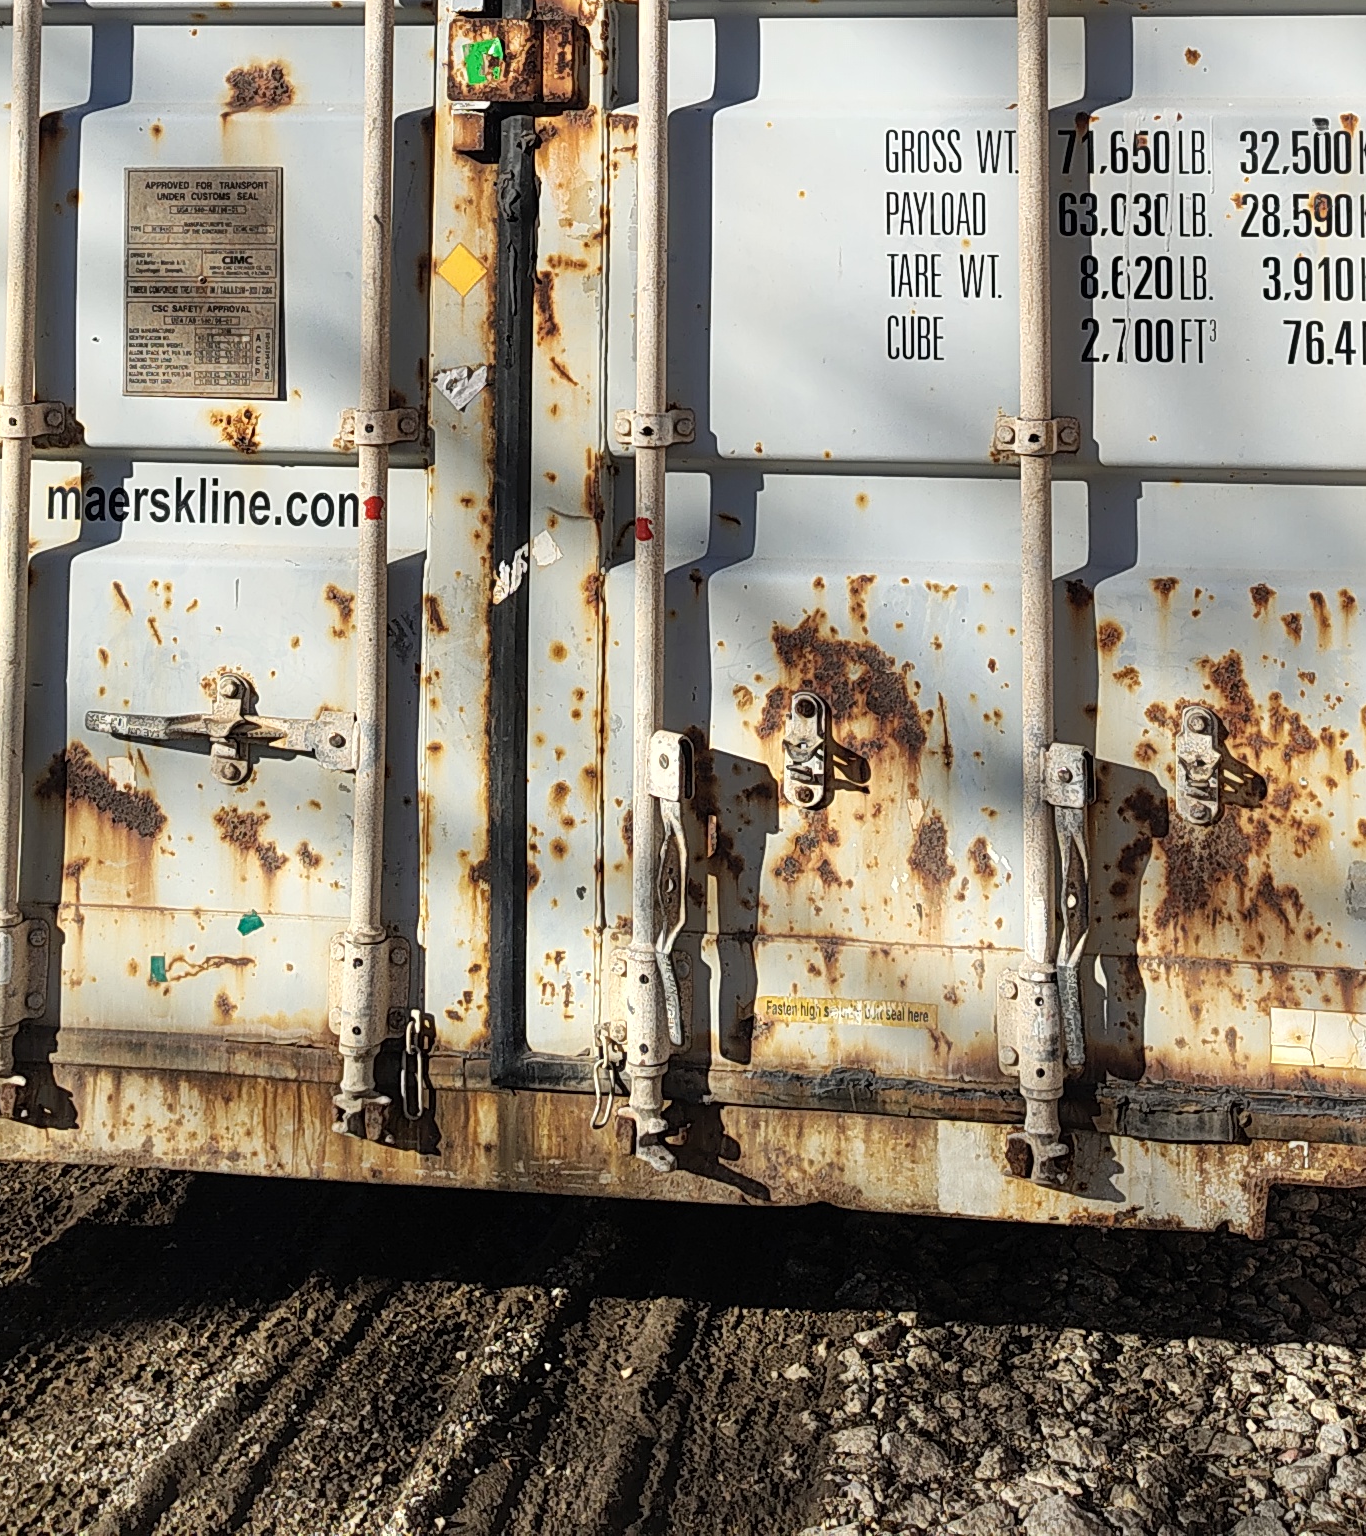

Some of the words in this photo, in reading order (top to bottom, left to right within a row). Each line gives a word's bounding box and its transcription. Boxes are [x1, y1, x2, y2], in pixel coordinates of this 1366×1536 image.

[885, 129, 963, 174] GROSS
[976, 129, 1019, 174] WT.
[1057, 129, 1170, 175] 71,650
[1178, 129, 1212, 175] LB.
[1239, 130, 1352, 175] 32,500
[144, 181, 190, 190] APPROVED
[195, 181, 213, 190] FOR
[220, 181, 269, 190] TRANSPORT
[156, 192, 185, 201] UNDER
[190, 192, 231, 201] CUSTOMS
[236, 192, 259, 201] SEAL
[886, 192, 987, 236] PAYLOAD
[1058, 192, 1172, 237] 63,030
[1179, 192, 1213, 238] LB.
[1240, 193, 1353, 238] 28,590
[222, 256, 254, 265] CIMC
[887, 253, 943, 298] TARE
[959, 253, 1003, 299] WT.
[1080, 255, 1173, 300] 8,620
[1180, 255, 1214, 301] LB.
[1262, 256, 1354, 302] 3,910
[151, 304, 169, 313] CSC
[171, 304, 204, 313] SAFETY
[206, 304, 252, 313] APPROVAL
[887, 315, 945, 361] CUBE
[1080, 318, 1174, 363] 2,700
[1282, 319, 1357, 366] 76.4
[766, 1000, 798, 1016] Fasten
[800, 1001, 822, 1021] high
[885, 1006, 905, 1021] seal
[907, 1007, 929, 1023] here
